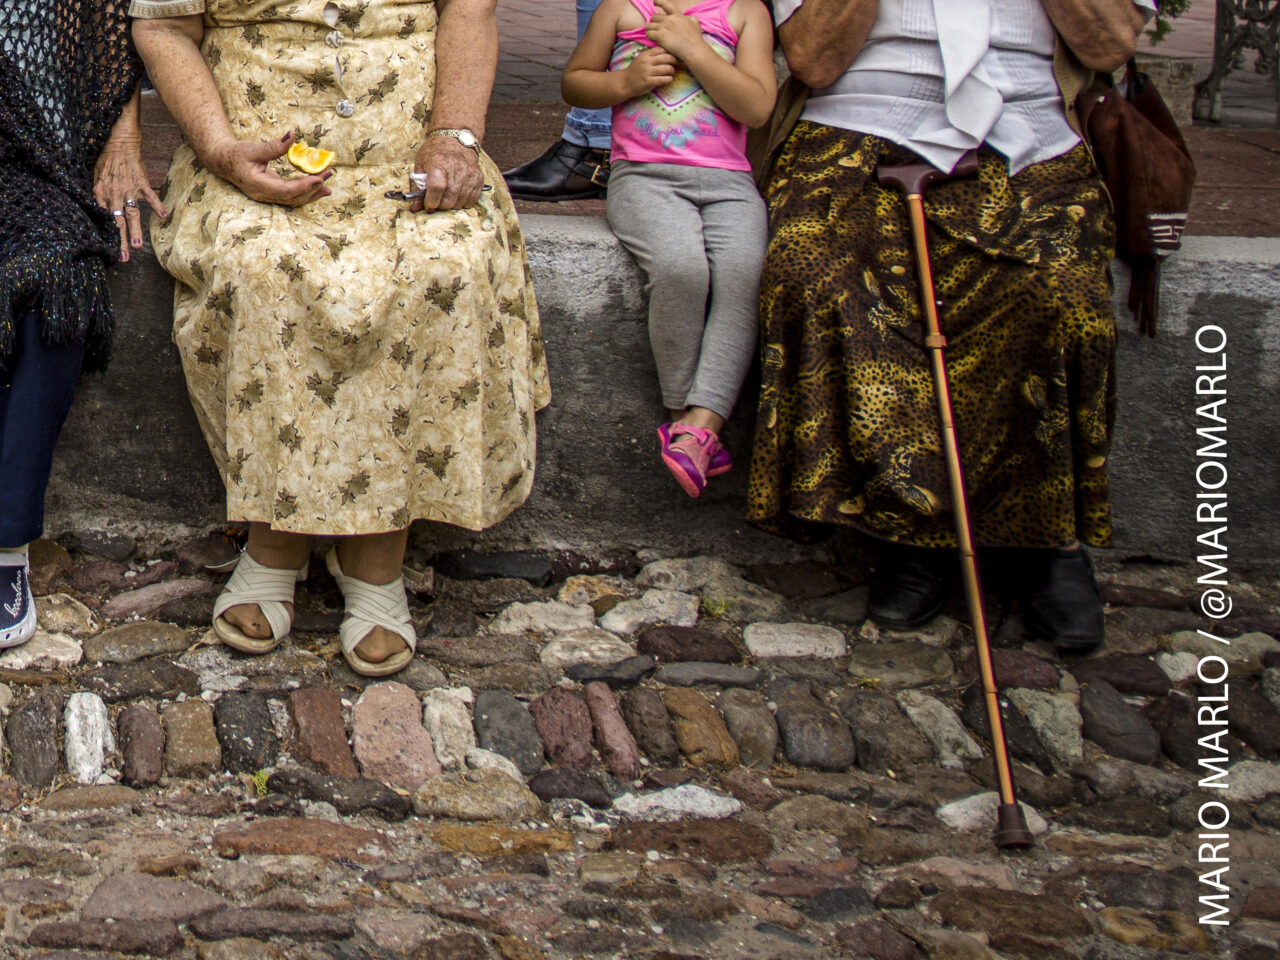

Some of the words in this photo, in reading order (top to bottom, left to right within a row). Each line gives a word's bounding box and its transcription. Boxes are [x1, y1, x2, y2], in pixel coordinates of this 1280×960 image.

[639, 122, 655, 136] all
[661, 127, 684, 143] you
[691, 126, 720, 137] need
[3, 569, 22, 619] bocoloco
